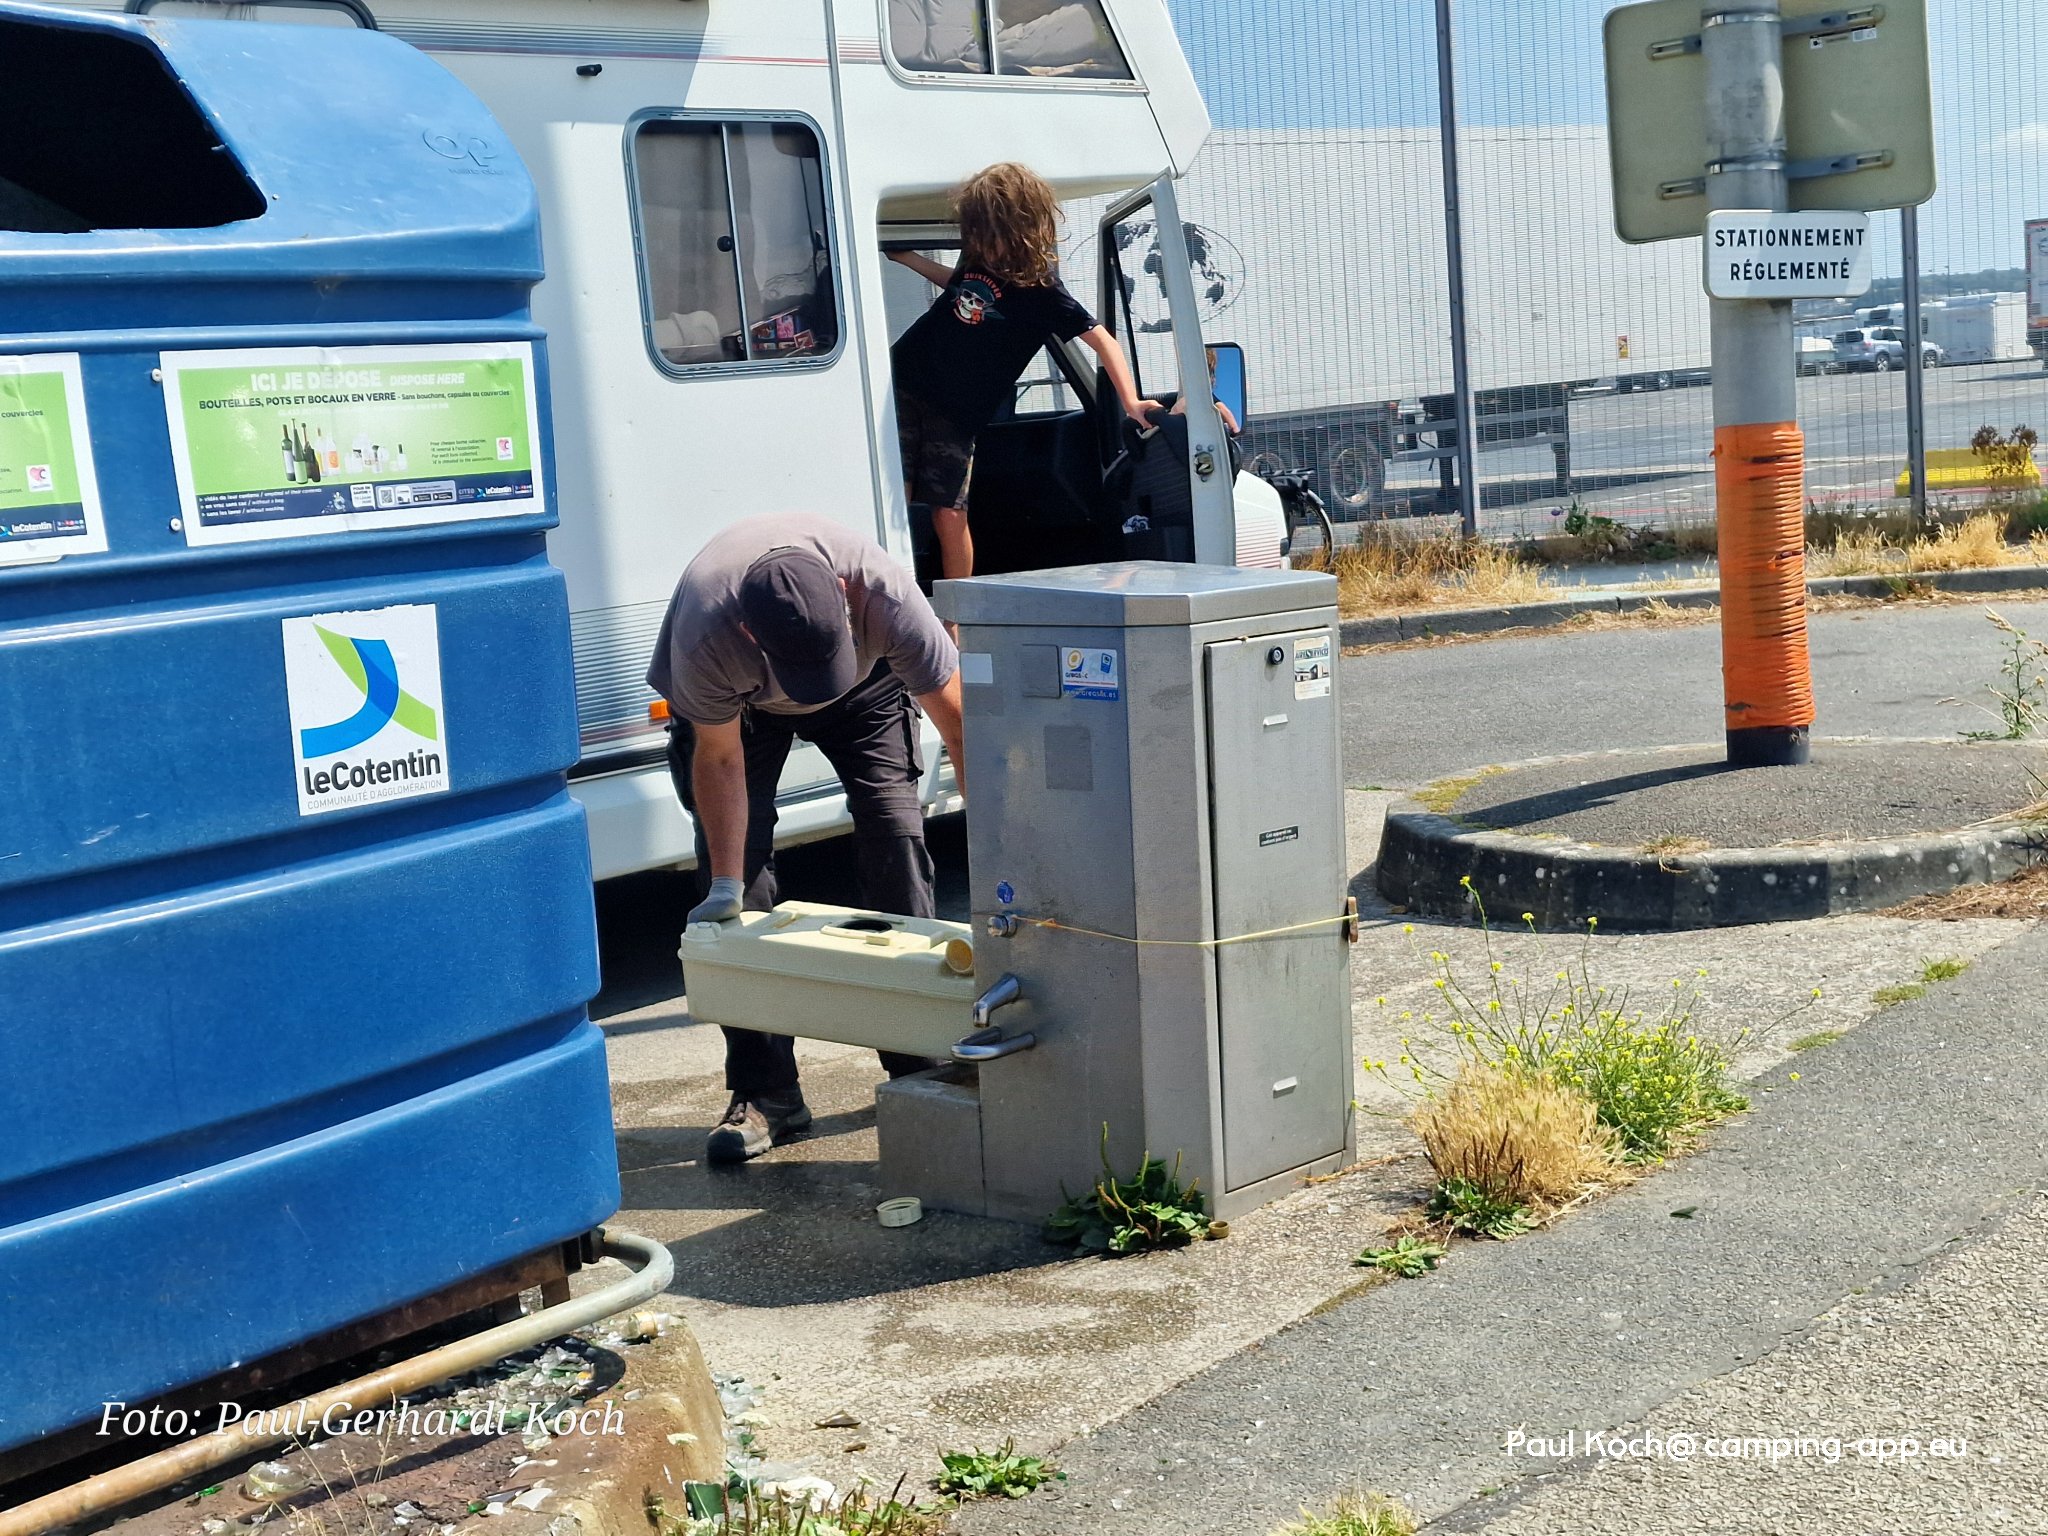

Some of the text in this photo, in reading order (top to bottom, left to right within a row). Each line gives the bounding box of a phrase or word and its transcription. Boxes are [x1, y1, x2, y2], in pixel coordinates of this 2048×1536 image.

[1715, 228, 1865, 247] STATIONNEMENT
[1730, 257, 1850, 281] RÉGLEMENTÉ
[251, 366, 381, 392] ICI JE DÉPOSE
[390, 372, 465, 386] DISPOSE HERE
[199, 397, 264, 409] BOUTEILLES,
[266, 396, 291, 406] POTS
[294, 395, 305, 405] ET
[308, 394, 350, 404] BOCAUX
[352, 393, 364, 402] EN
[366, 392, 396, 401] VERRE
[1, 409, 43, 418] couvercles
[304, 749, 441, 795] leCotentin
[307, 788, 368, 810] COMMUNAUTÉ
